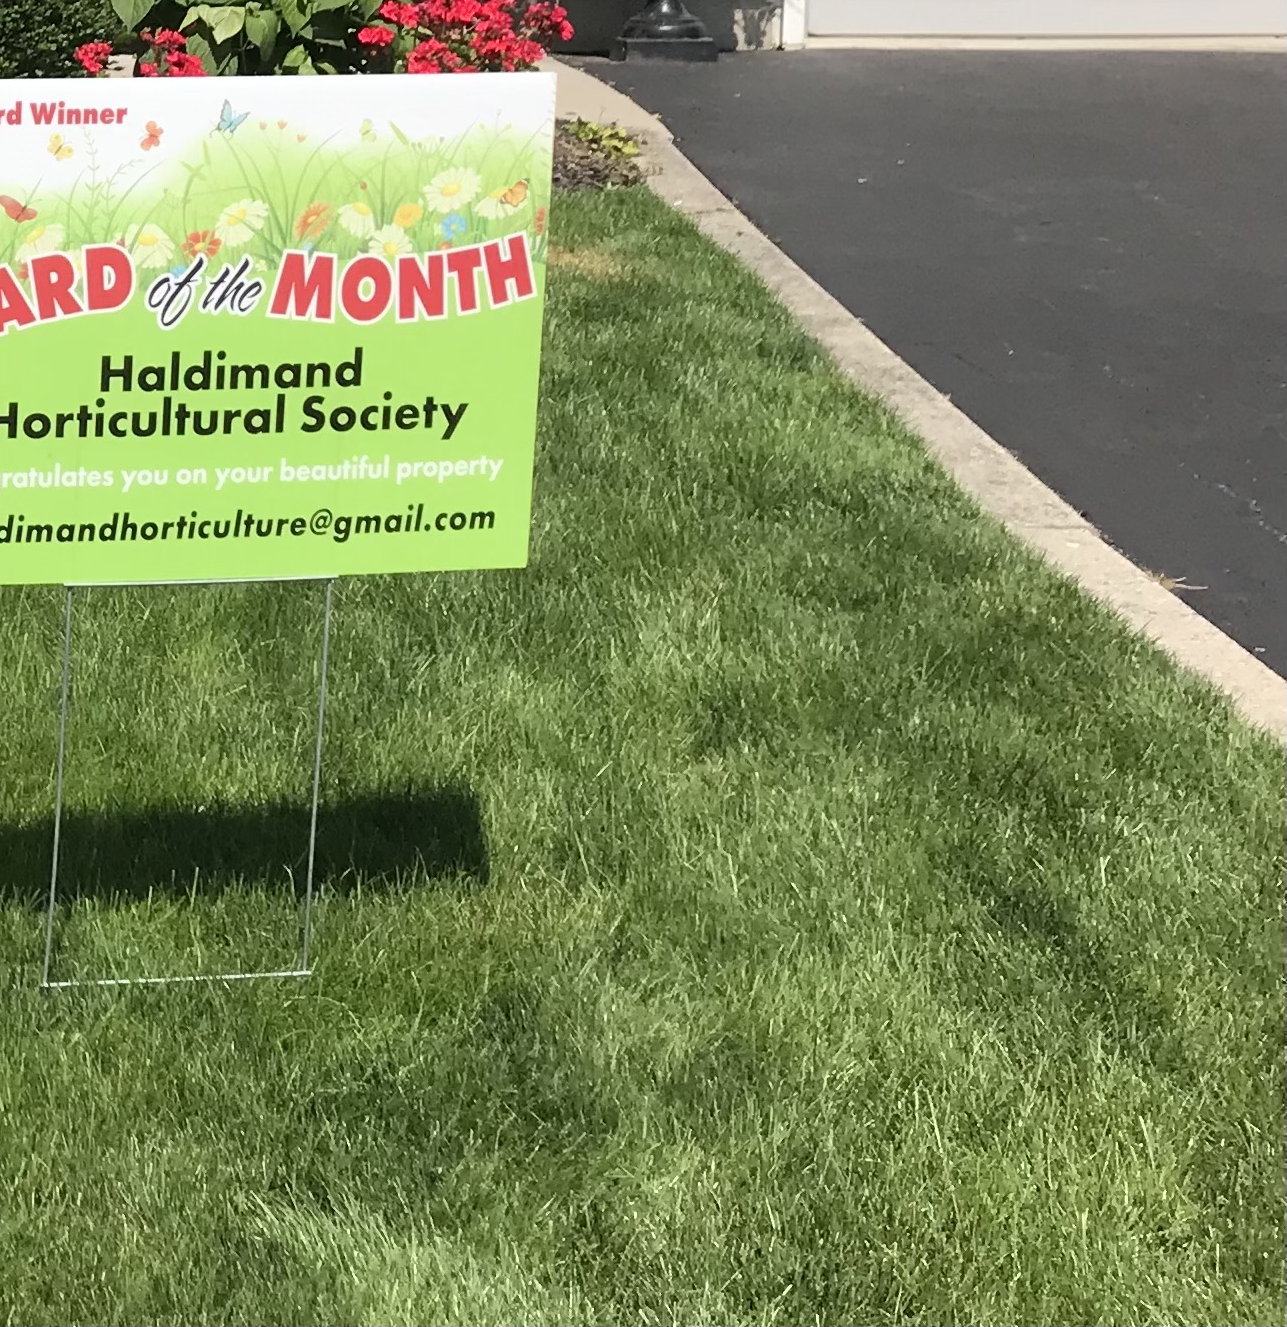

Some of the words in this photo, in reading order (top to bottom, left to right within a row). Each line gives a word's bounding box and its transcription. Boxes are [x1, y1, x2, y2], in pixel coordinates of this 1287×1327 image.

[29, 101, 129, 126] Winner
[147, 257, 203, 326] of
[202, 257, 261, 314] the
[269, 234, 534, 322] MONTH
[99, 347, 363, 393] Haldimand
[301, 390, 469, 440] Society
[120, 468, 171, 494] you
[176, 466, 208, 486] on
[213, 463, 274, 491] your
[279, 455, 390, 484] beautiful
[396, 453, 504, 484] property
